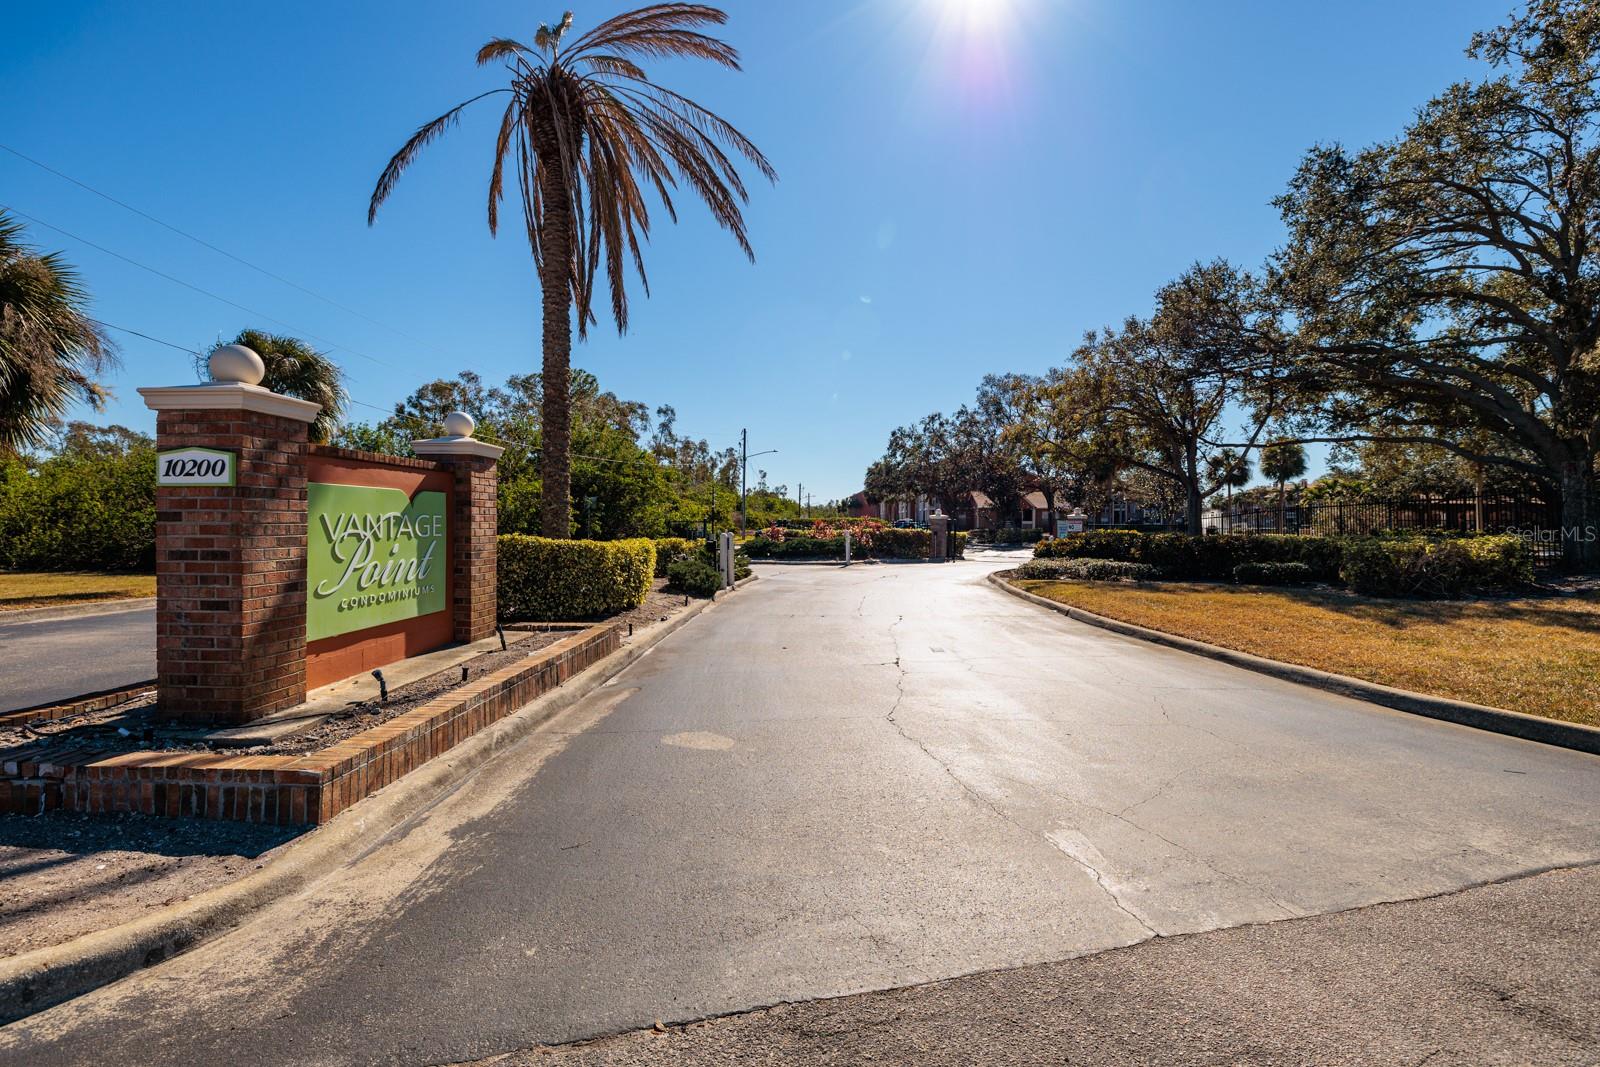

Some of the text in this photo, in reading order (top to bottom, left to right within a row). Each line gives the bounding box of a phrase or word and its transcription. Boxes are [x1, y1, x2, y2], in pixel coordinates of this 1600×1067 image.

[162, 458, 226, 477] 10200
[322, 512, 442, 541] VANTAGE
[317, 512, 437, 595] Point
[341, 584, 435, 608] CONDOMINIUMS
